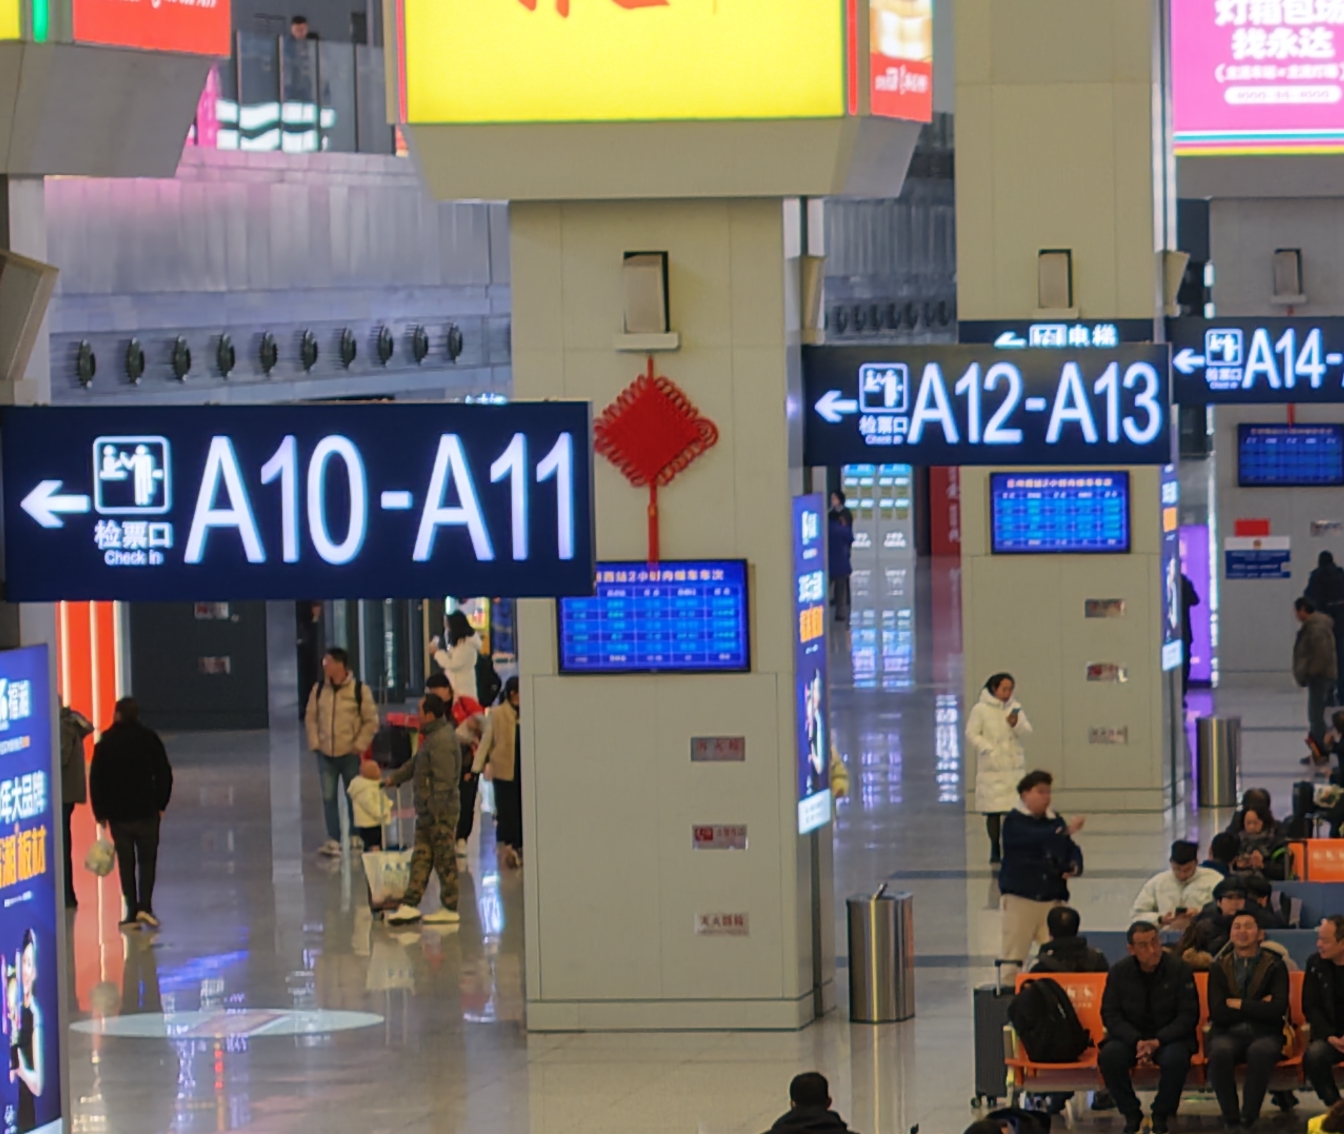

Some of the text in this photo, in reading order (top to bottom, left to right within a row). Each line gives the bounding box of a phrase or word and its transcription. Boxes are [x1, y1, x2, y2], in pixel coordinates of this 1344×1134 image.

[906, 361, 1163, 445] A12-A13
[184, 432, 574, 565] A10-A11
[94, 519, 174, 550] 检票口
[104, 550, 164, 566] Check in
